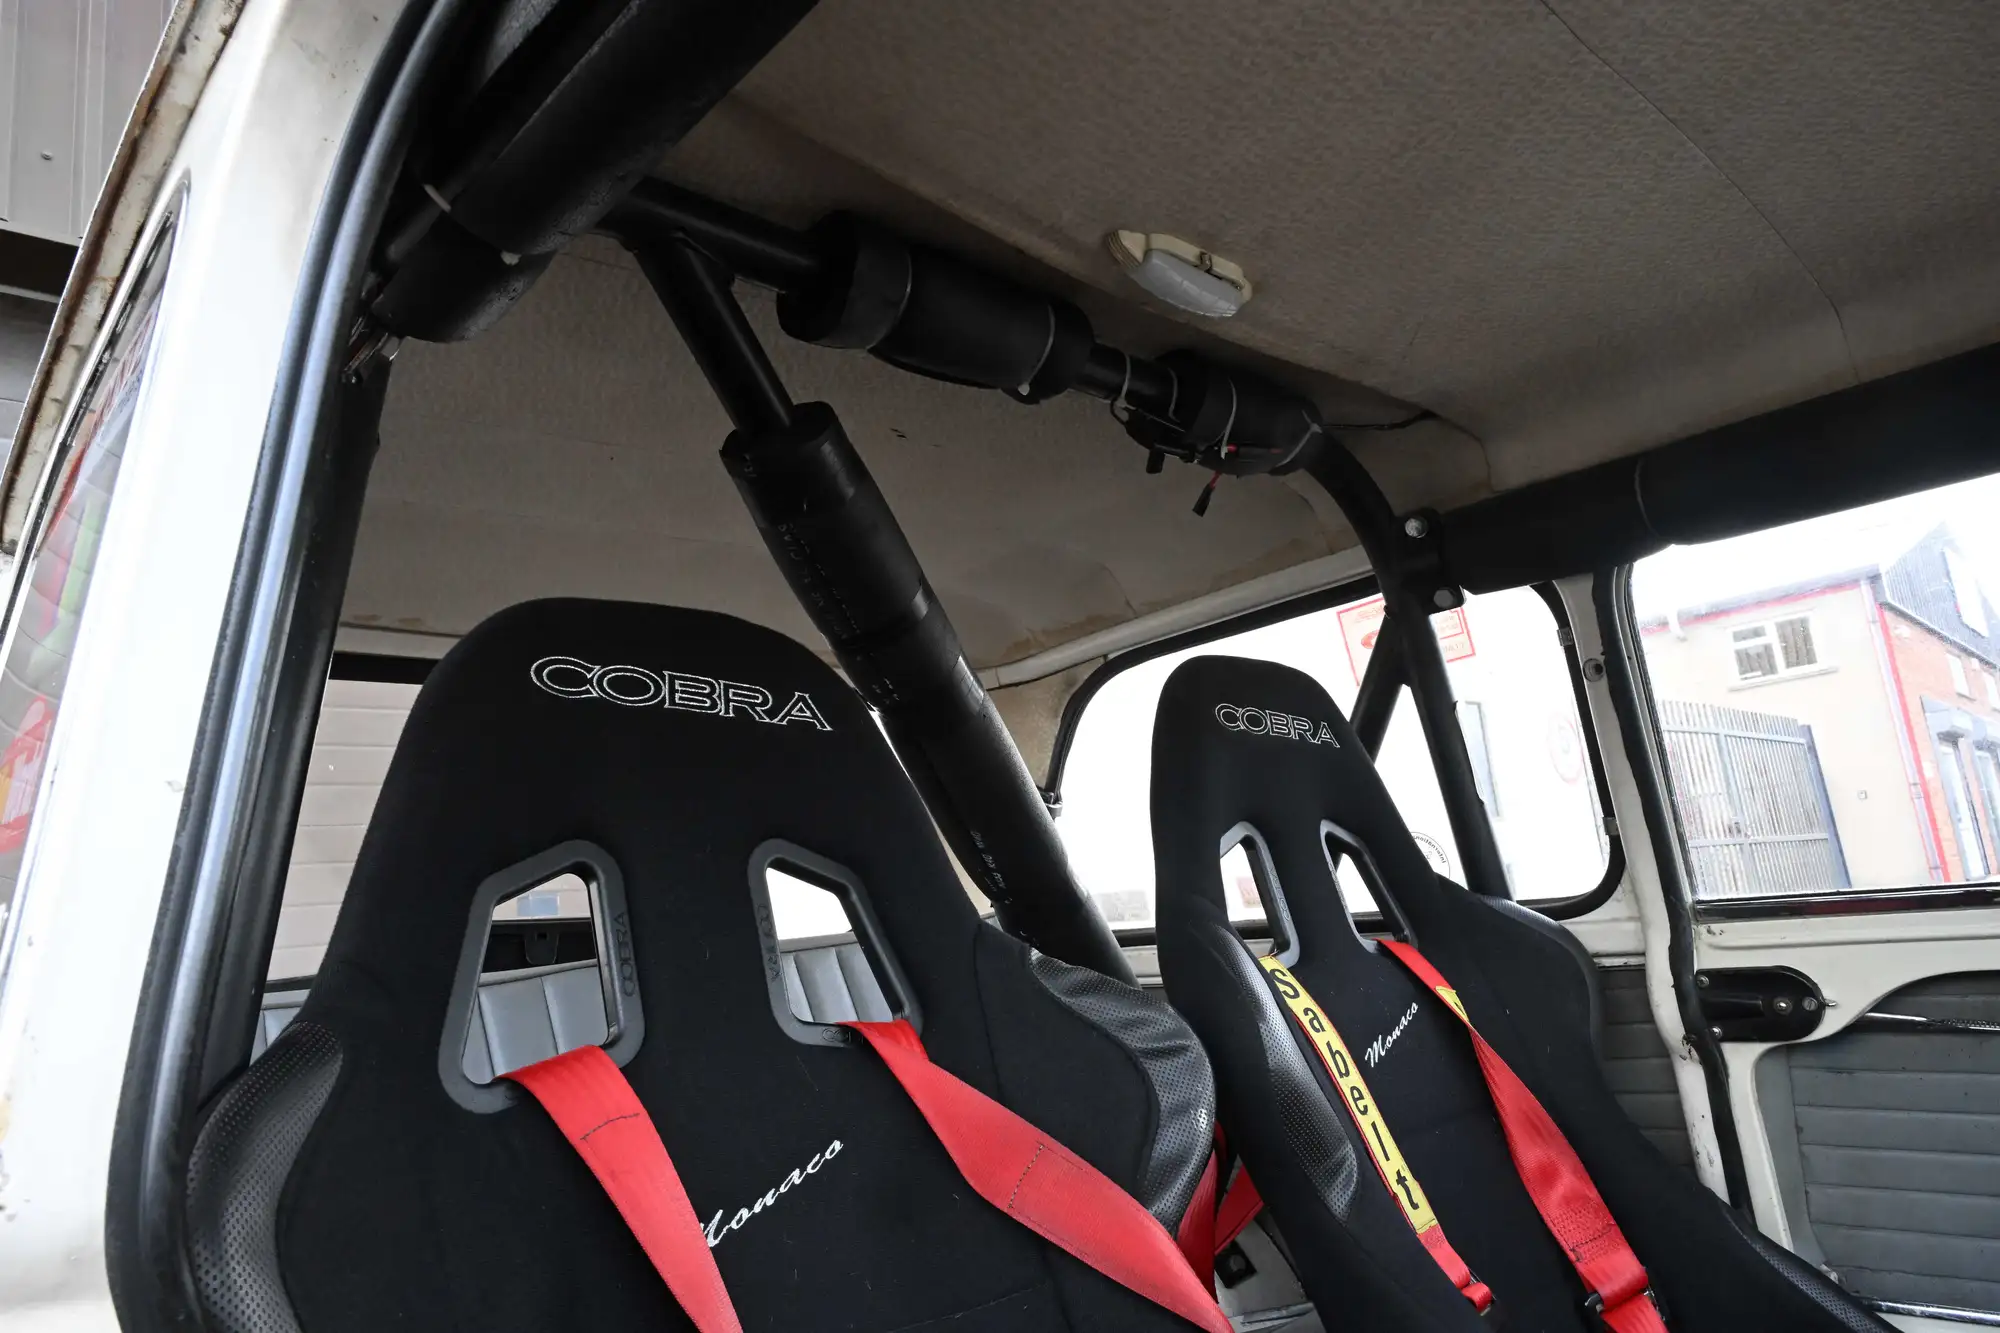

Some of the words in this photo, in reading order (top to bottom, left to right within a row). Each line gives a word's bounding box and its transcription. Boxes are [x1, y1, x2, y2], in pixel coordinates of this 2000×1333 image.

[530, 655, 833, 731] COBRA
[1214, 703, 1341, 748] COBRA
[1364, 1002, 1419, 1068] Monaco
[1268, 968, 1420, 1210] Sabelt
